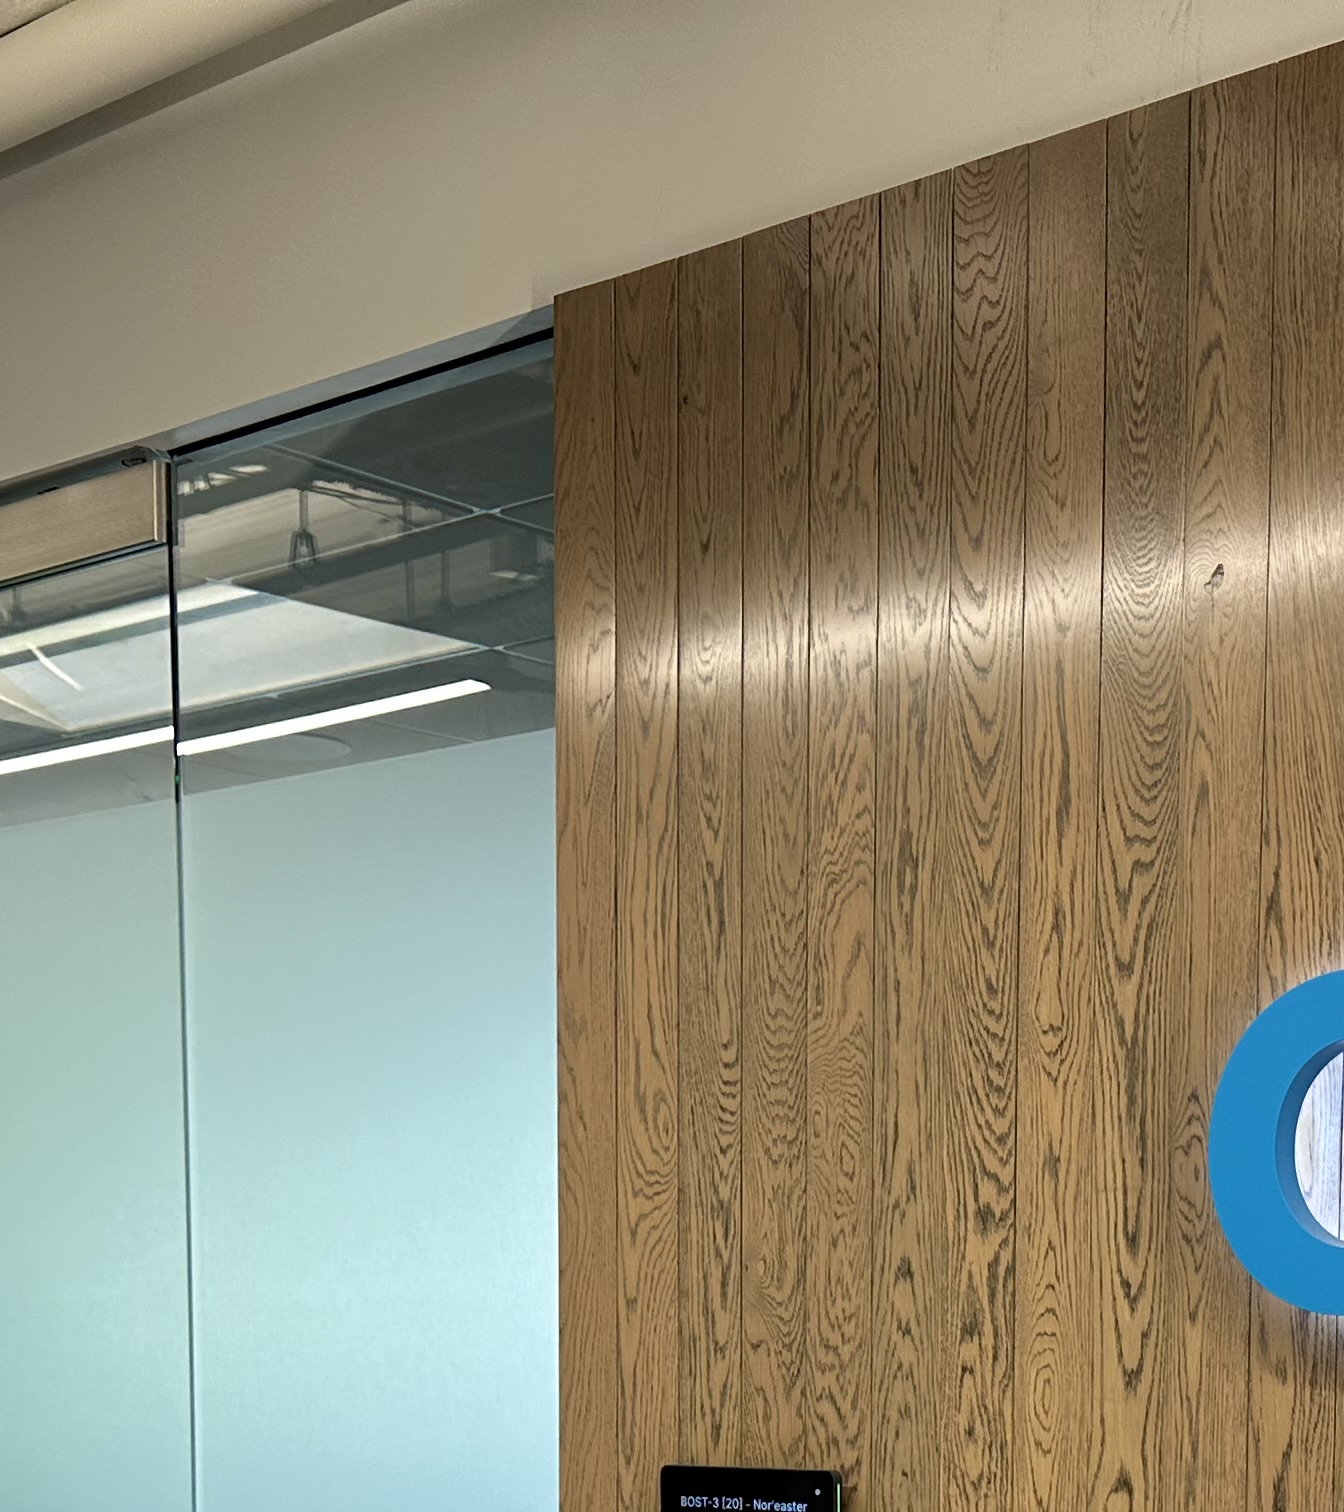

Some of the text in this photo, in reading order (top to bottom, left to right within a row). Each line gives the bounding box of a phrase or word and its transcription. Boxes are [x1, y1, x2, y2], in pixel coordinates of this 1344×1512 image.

[680, 1495, 720, 1509] BOST-3
[722, 1496, 743, 1511] [20]
[753, 1499, 808, 1512] Nor'easter
